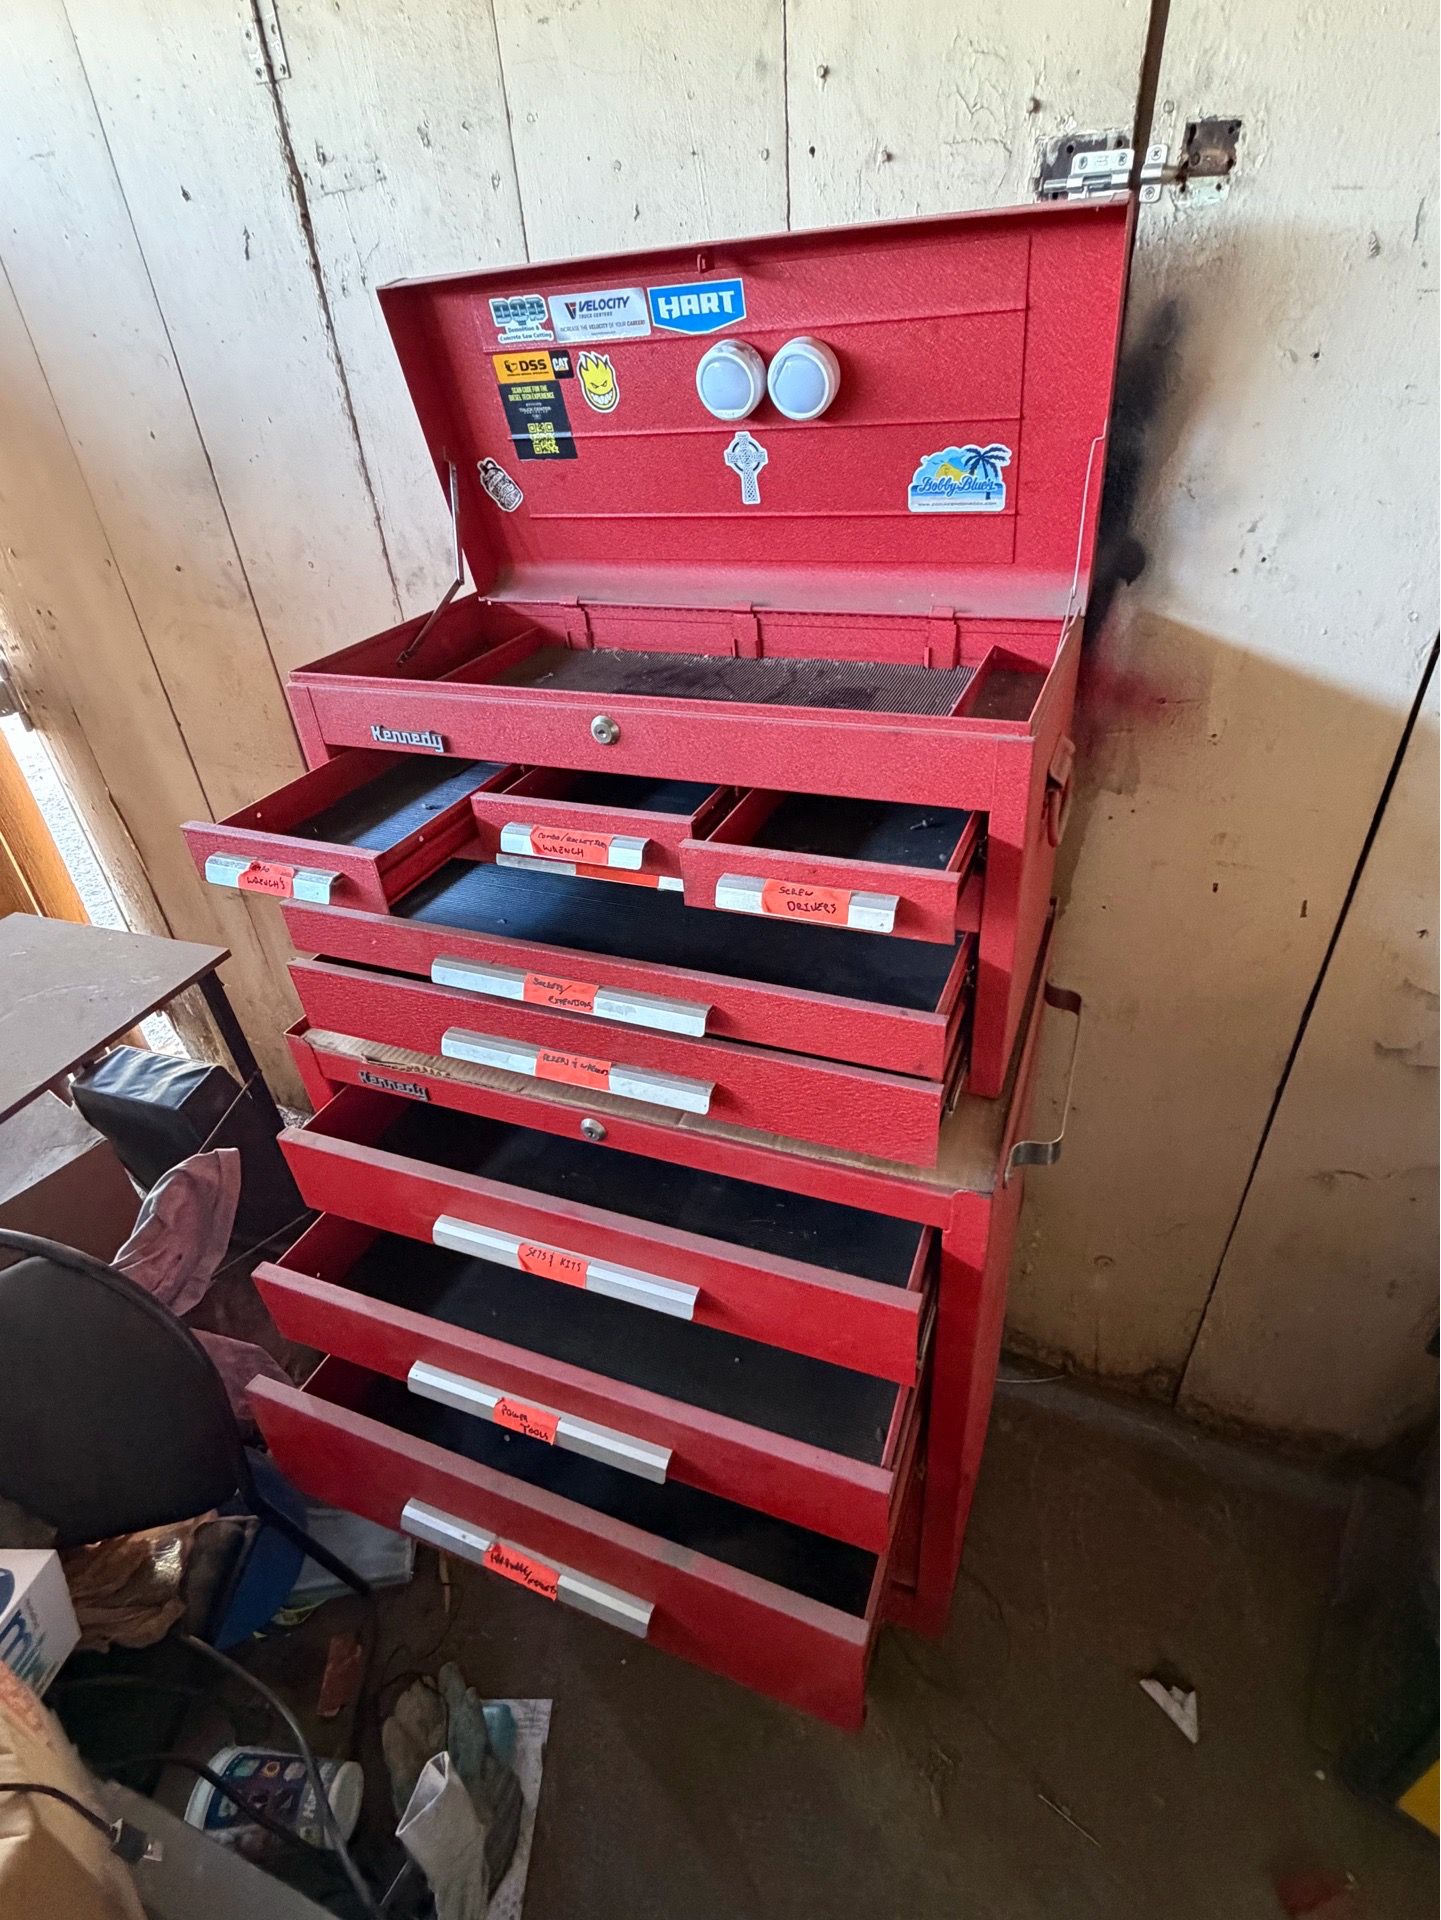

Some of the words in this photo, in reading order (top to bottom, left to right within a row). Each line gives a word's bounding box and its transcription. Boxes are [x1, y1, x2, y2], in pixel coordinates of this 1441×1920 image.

[579, 296, 630, 312] VELOCITY
[657, 290, 735, 319] HART
[519, 359, 547, 372] DSS
[552, 357, 569, 372] CAT
[918, 477, 957, 497] Bobby
[370, 725, 444, 753] Kennedy
[542, 844, 584, 858] WRENCH
[778, 886, 813, 897] SCREW
[787, 900, 837, 914] DRIVERS
[359, 1071, 429, 1102] Kennedy
[525, 1246, 547, 1261] SETS
[559, 1256, 582, 1273] KITS
